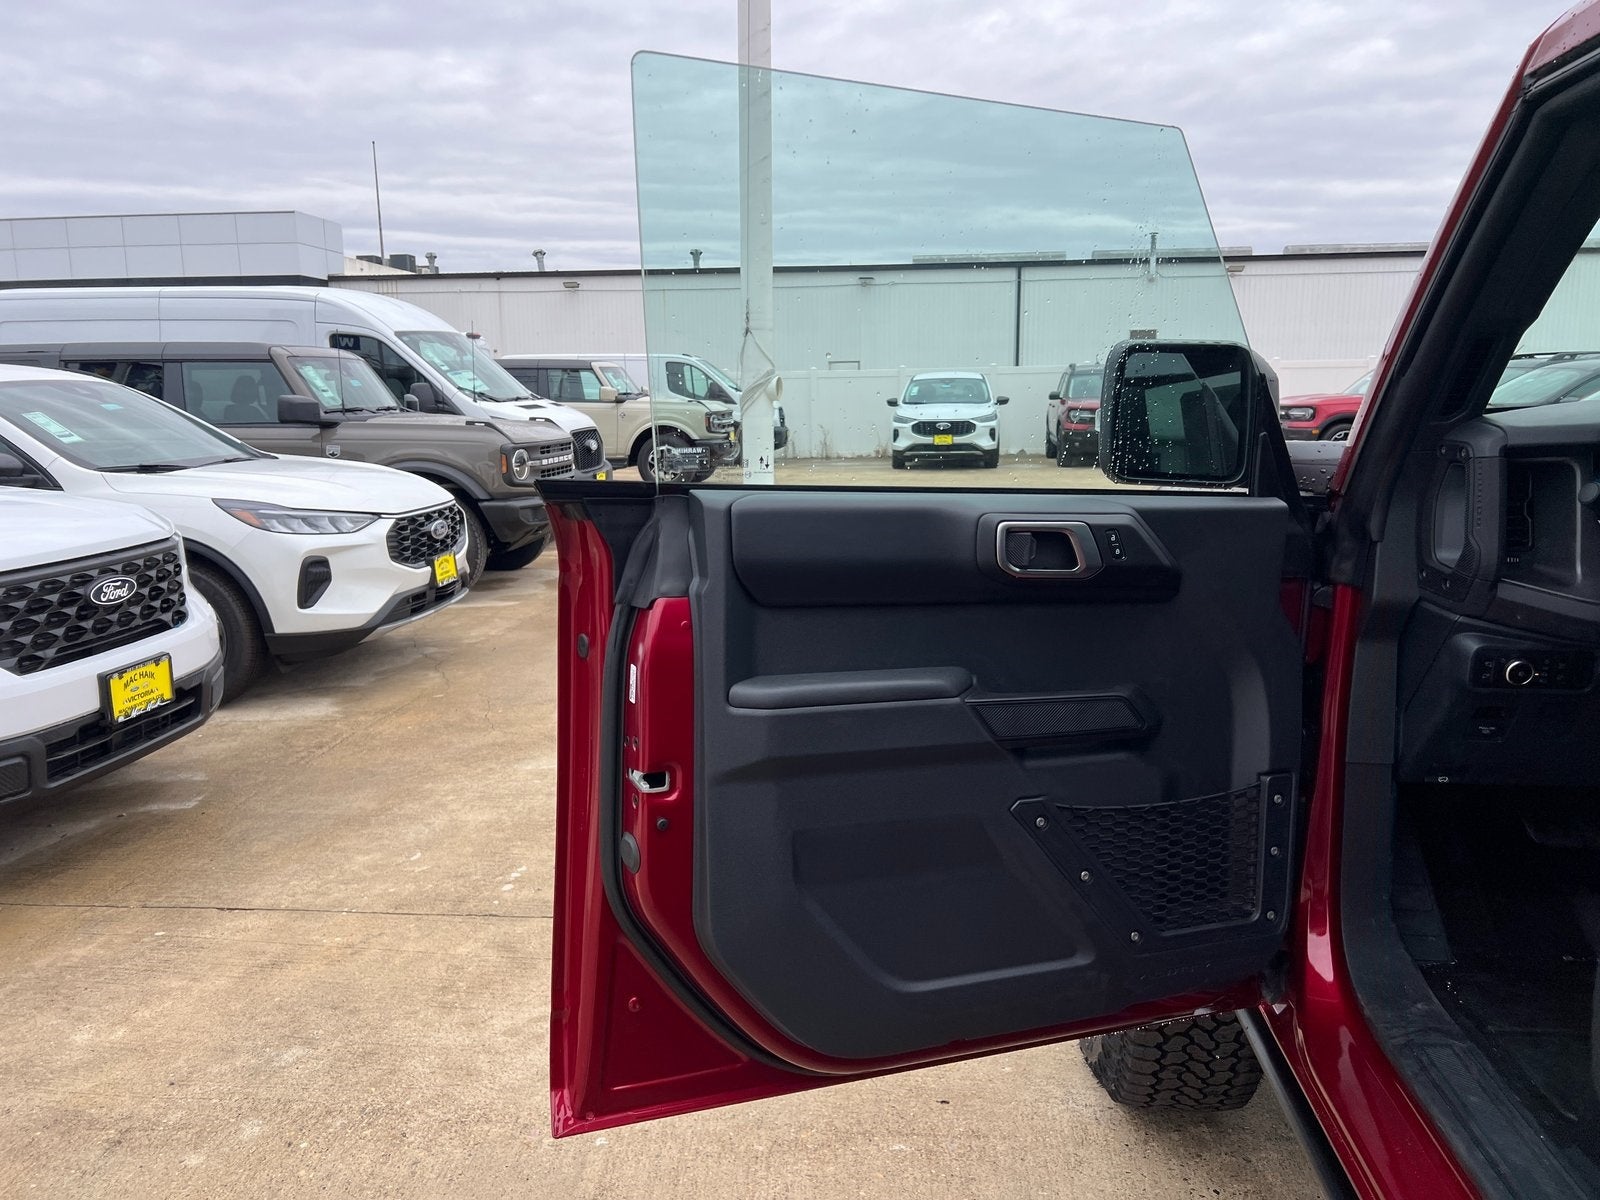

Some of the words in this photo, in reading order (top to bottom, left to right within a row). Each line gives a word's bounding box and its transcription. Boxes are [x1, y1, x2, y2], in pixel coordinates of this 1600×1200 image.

[100, 581, 129, 601] Ford
[123, 673, 138, 691] MAC
[138, 670, 156, 681] HAIK
[125, 688, 155, 705] VICTORIA
